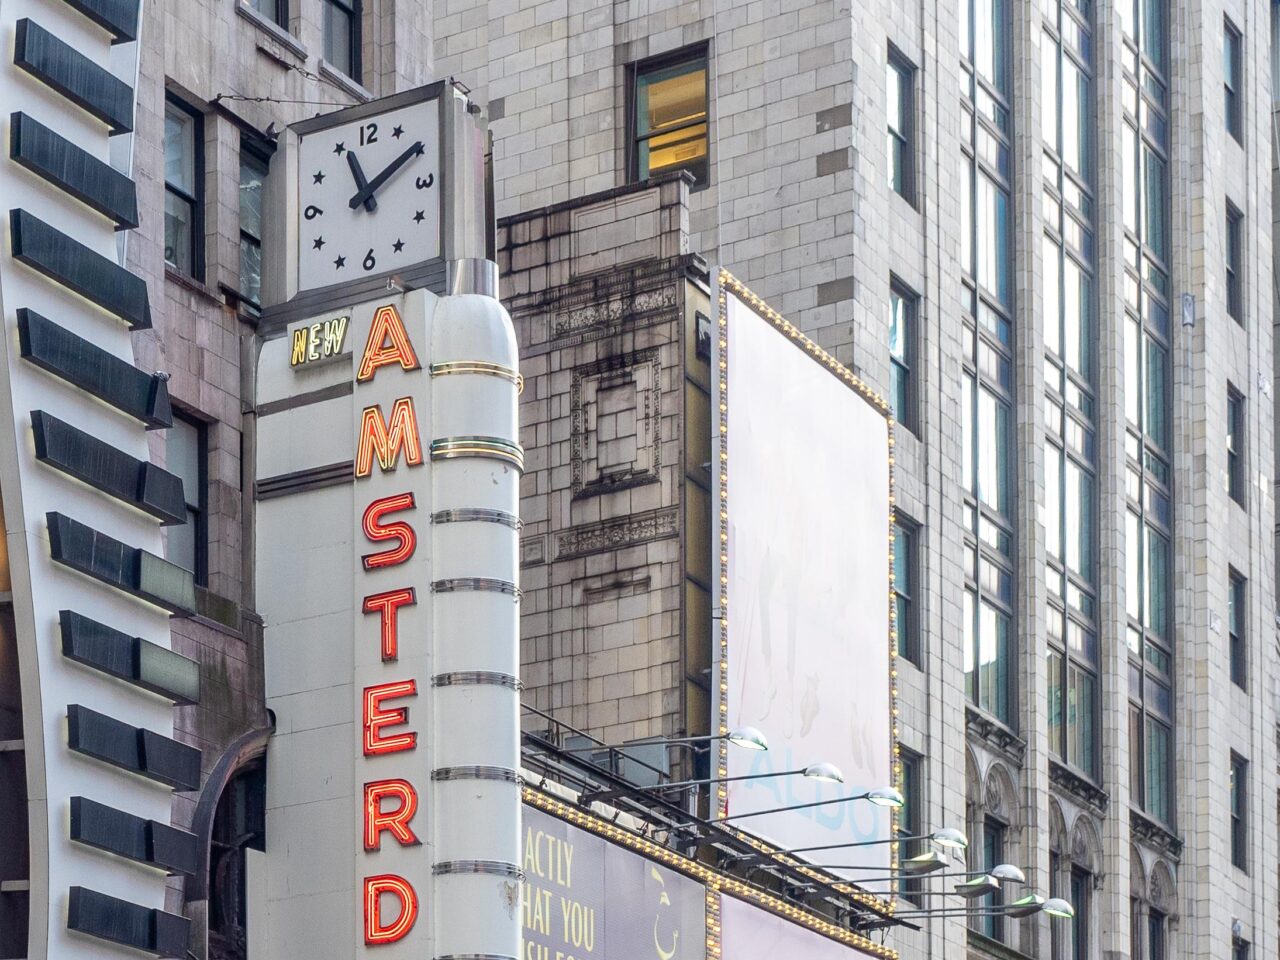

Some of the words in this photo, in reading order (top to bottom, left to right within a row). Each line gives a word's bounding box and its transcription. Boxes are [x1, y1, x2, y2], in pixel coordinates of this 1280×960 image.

[358, 122, 379, 147] 12
[415, 173, 434, 190] 3
[362, 248, 376, 271] 6
[291, 316, 349, 369] NEW
[524, 826, 573, 888] ACTLY
[561, 897, 594, 952] YOU
